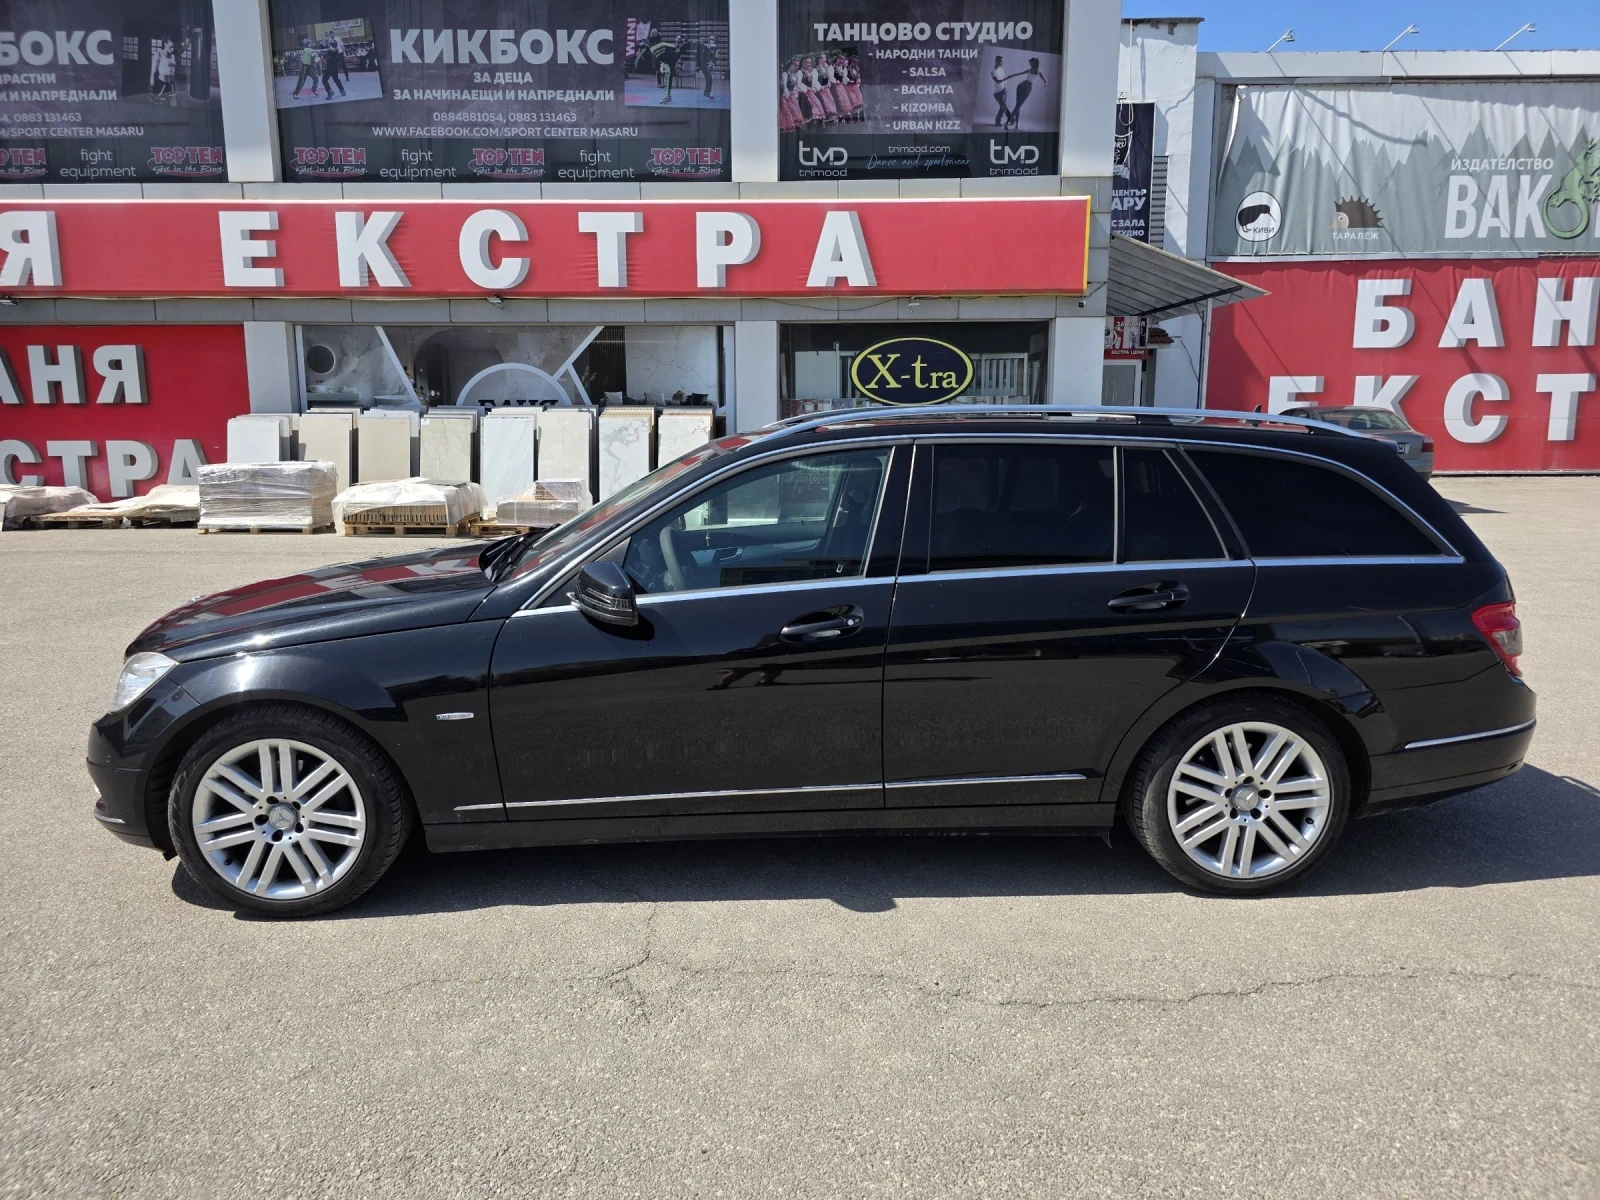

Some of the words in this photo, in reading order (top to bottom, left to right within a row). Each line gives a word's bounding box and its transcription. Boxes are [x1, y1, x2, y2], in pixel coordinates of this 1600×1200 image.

[814, 22, 931, 44] ТАНЦОВО
[935, 21, 1033, 43] СТУДИО
[390, 29, 614, 65] КИКБОКС
[876, 50, 936, 60] НАРОДНИ
[938, 49, 978, 60] ТАНЦИ
[474, 72, 491, 83] ЗА
[494, 72, 533, 84] ДЕЦА
[910, 67, 946, 77] SALSA
[0, 73, 57, 85] РАСТНИ
[10, 91, 20, 102] И
[22, 90, 118, 102] НАПРЕДНАЛИ
[394, 89, 412, 100] ЗА
[414, 89, 504, 102] НАЧИНАЕЩИ
[506, 90, 516, 100] И
[518, 90, 614, 102] НАПРЕДНАЛИ
[902, 85, 954, 95] BACHATA
[900, 103, 953, 113] KIZOMBA
[14, 113, 42, 122] 0883
[45, 112, 82, 122] 131463
[433, 112, 506, 124] 0884881054,
[508, 112, 537, 122] 0883
[540, 112, 577, 122] 131463
[50, 126, 94, 136] CENTER
[96, 126, 144, 136] MASARU
[893, 121, 934, 130] URBAN
[936, 120, 960, 130] KIZZ
[372, 126, 542, 138] WWW.FACEBOOK.COM/SPORT
[544, 127, 588, 137] CENTER
[590, 127, 638, 137] MASARU
[150, 146, 186, 164] TOP
[186, 146, 223, 164] TEN
[294, 146, 330, 164] TOP
[329, 147, 366, 164] TEN
[888, 144, 950, 154] trimood.com
[8, 148, 46, 166] TEN
[80, 149, 112, 164] fight
[402, 149, 433, 164] fight
[472, 148, 508, 166] TOP
[508, 148, 544, 166] TEN
[580, 150, 611, 165] fight
[650, 148, 686, 165] TOP
[686, 147, 722, 165] TEN
[867, 153, 896, 170] Dance
[902, 153, 921, 168] and
[924, 154, 970, 172] sportswear
[990, 166, 1038, 176] trimood
[1451, 158, 1554, 172] ИЗДАТЕЛСТВО
[60, 166, 136, 180] equipment
[380, 166, 456, 180] equipment
[558, 166, 635, 181] equipment
[799, 168, 848, 177] trimood
[1112, 189, 1147, 197] ЦЕНТЪР
[1118, 219, 1145, 228] ЗАЛА
[1331, 232, 1380, 240] ТАРАЛЕЖ
[218, 209, 878, 290] ЕКСТРА
[1353, 277, 1600, 349] БАН
[865, 353, 960, 390] X-tra
